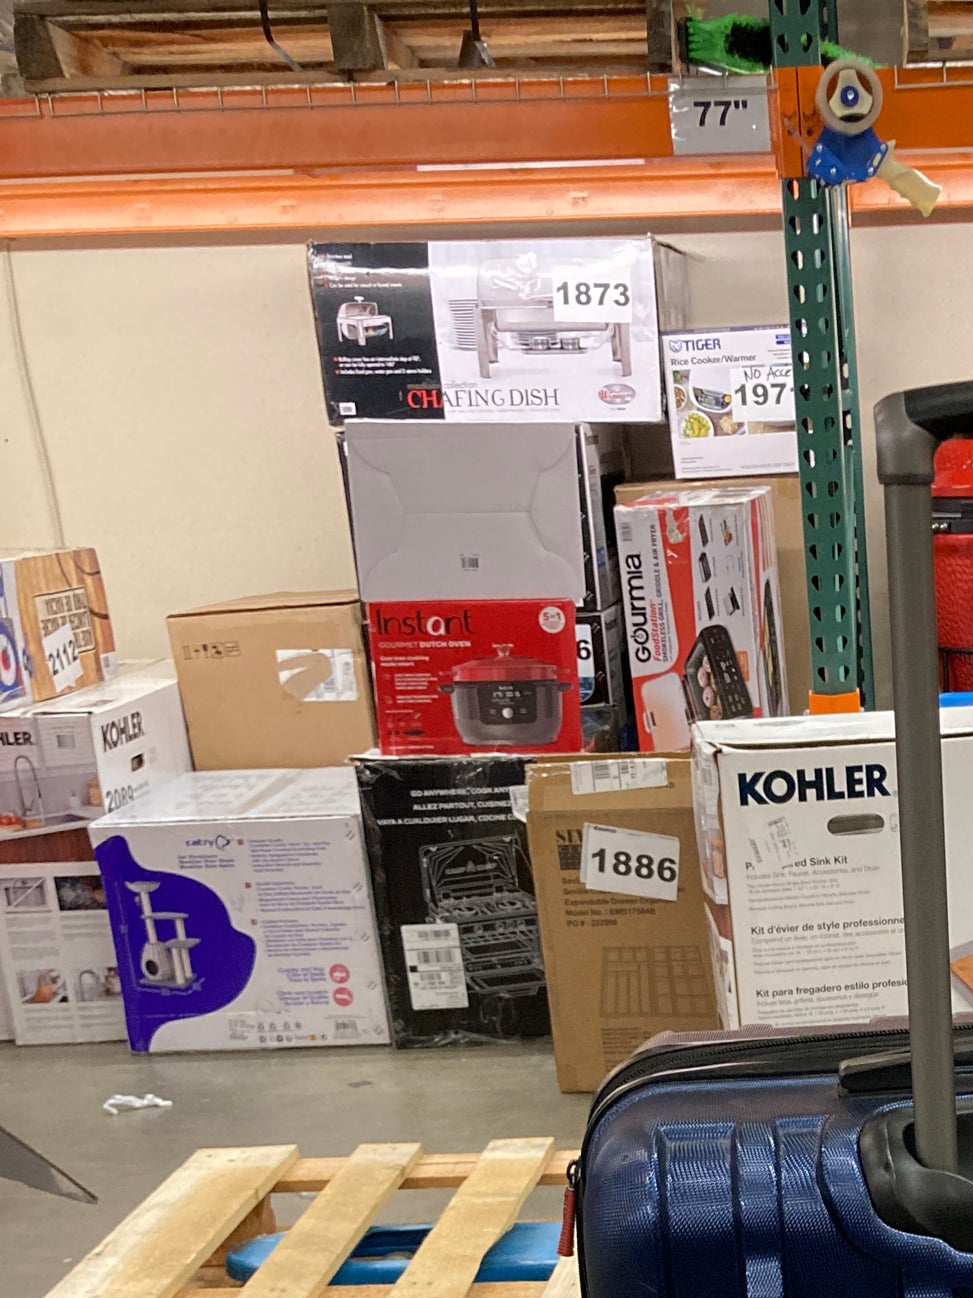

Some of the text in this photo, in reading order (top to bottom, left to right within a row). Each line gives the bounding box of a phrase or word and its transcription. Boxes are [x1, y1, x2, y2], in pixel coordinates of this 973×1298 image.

[693, 100, 748, 126] 77"
[556, 280, 630, 307] 1873
[683, 338, 721, 352] TIGER
[670, 355, 757, 366] Rice Cooker/Warmer
[406, 388, 560, 409] CHAFING DISH
[734, 382, 794, 407] 197
[626, 553, 651, 663] Gourmia
[376, 609, 475, 636] Instant
[48, 639, 79, 676] 2112
[100, 711, 145, 752] KOHLER
[738, 762, 891, 807] KOHLER
[592, 848, 677, 882] 1886
[809, 856, 831, 866] Sink
[834, 855, 848, 865] Kit
[750, 926, 764, 935] Kit
[768, 924, 799, 934] d'évier
[802, 923, 815, 932] de
[817, 921, 840, 932] style
[756, 989, 769, 998] Kit
[772, 988, 793, 998] para
[796, 984, 842, 996] fregadero
[844, 982, 870, 991] estilo
